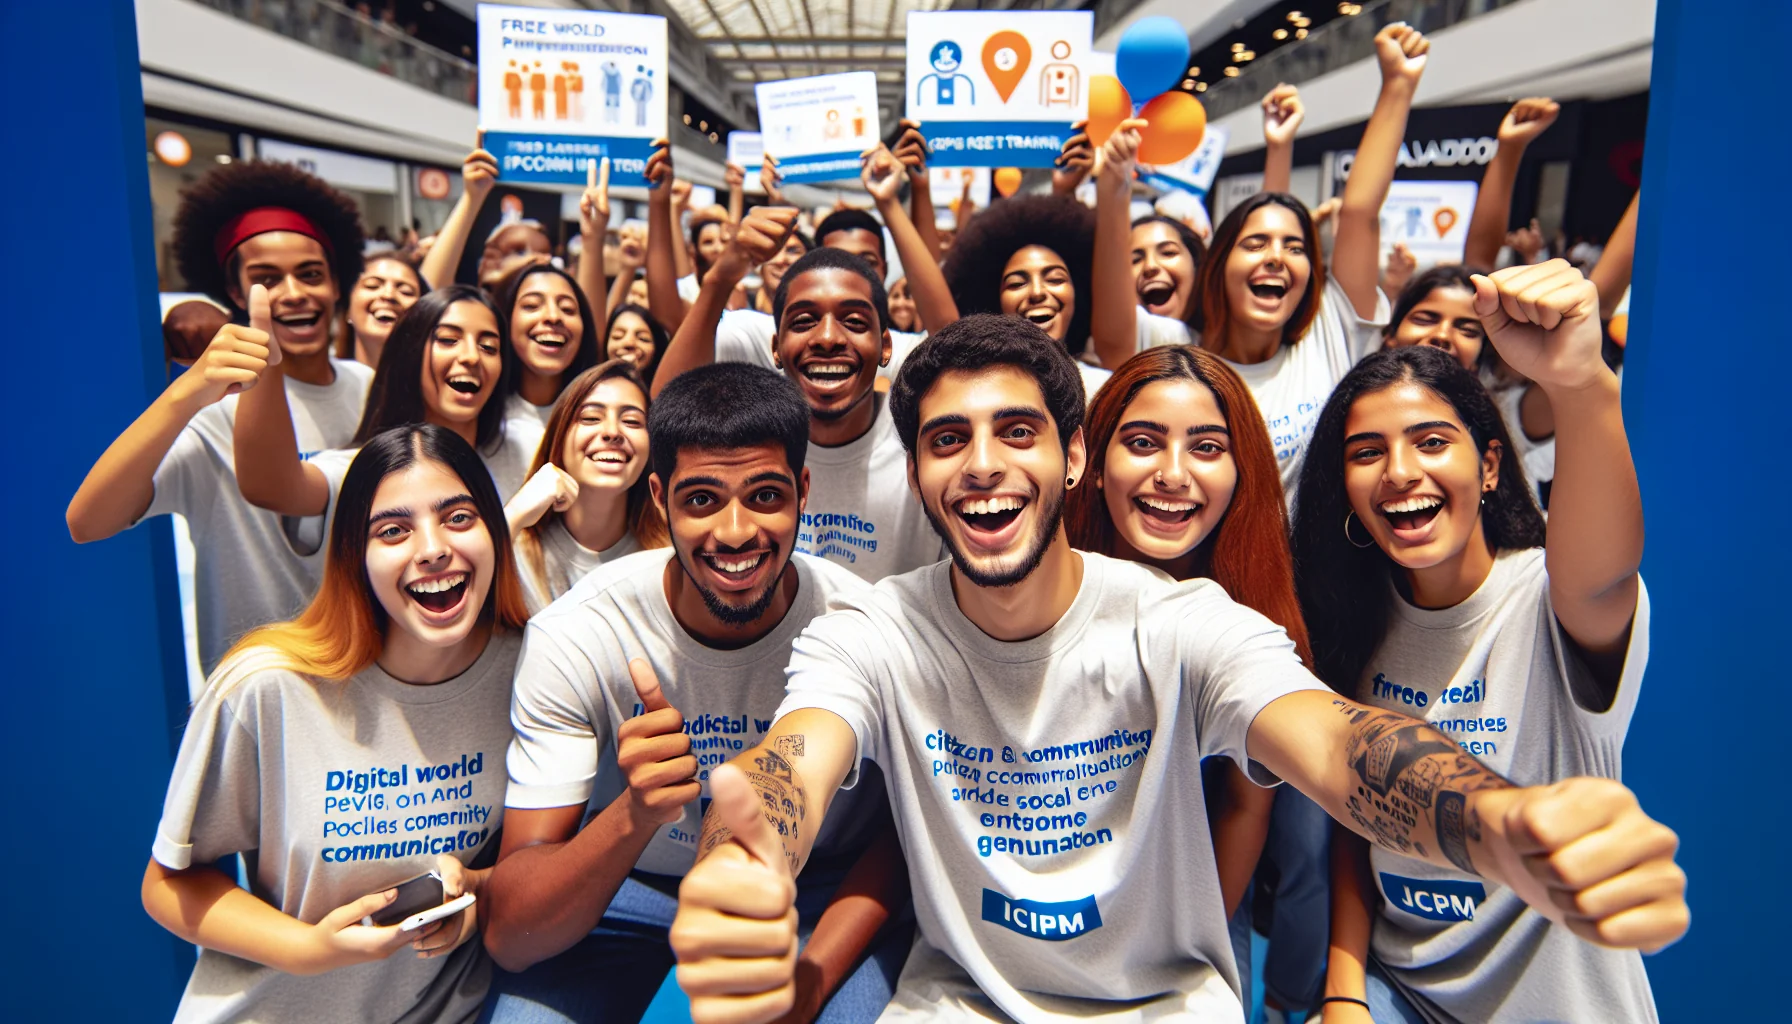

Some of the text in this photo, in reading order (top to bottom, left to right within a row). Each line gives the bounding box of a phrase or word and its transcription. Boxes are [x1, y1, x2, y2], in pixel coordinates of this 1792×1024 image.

[325, 752, 483, 794] Digital world
[396, 792, 426, 809] on
[431, 780, 473, 802] And
[1004, 901, 1085, 935] ICIPM
